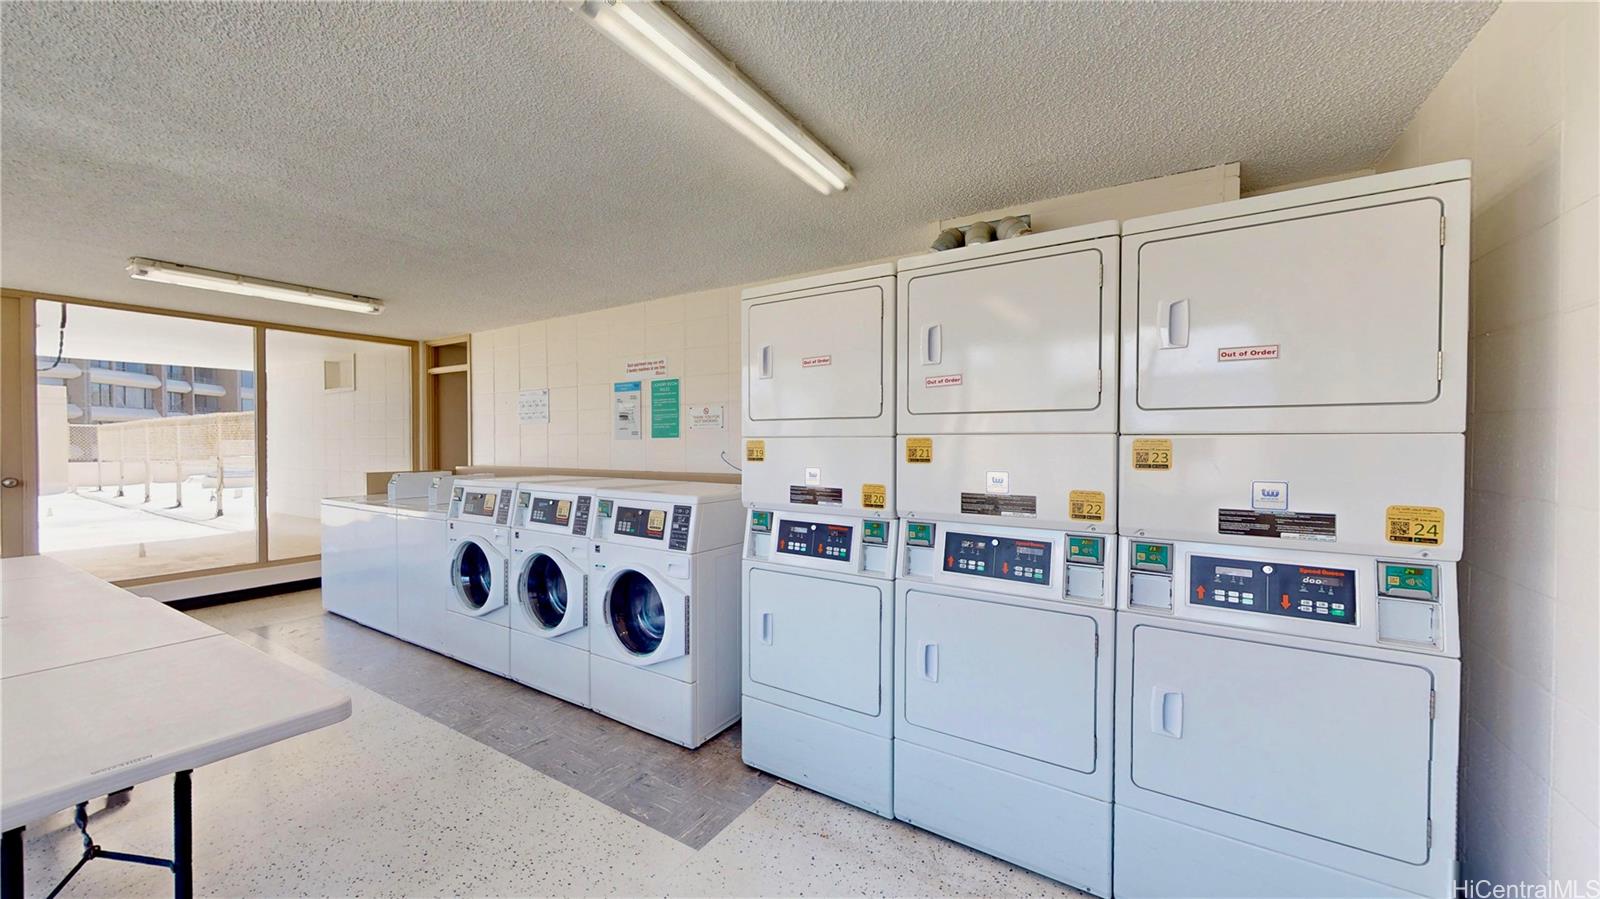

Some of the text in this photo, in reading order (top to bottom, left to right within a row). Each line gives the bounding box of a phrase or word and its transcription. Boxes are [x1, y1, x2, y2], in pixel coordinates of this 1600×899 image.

[755, 448, 764, 457] 19
[919, 449, 931, 458] 21
[1152, 452, 1169, 463] 23
[873, 494, 884, 504] 20
[1086, 504, 1102, 515] 22
[1414, 523, 1439, 537] 24
